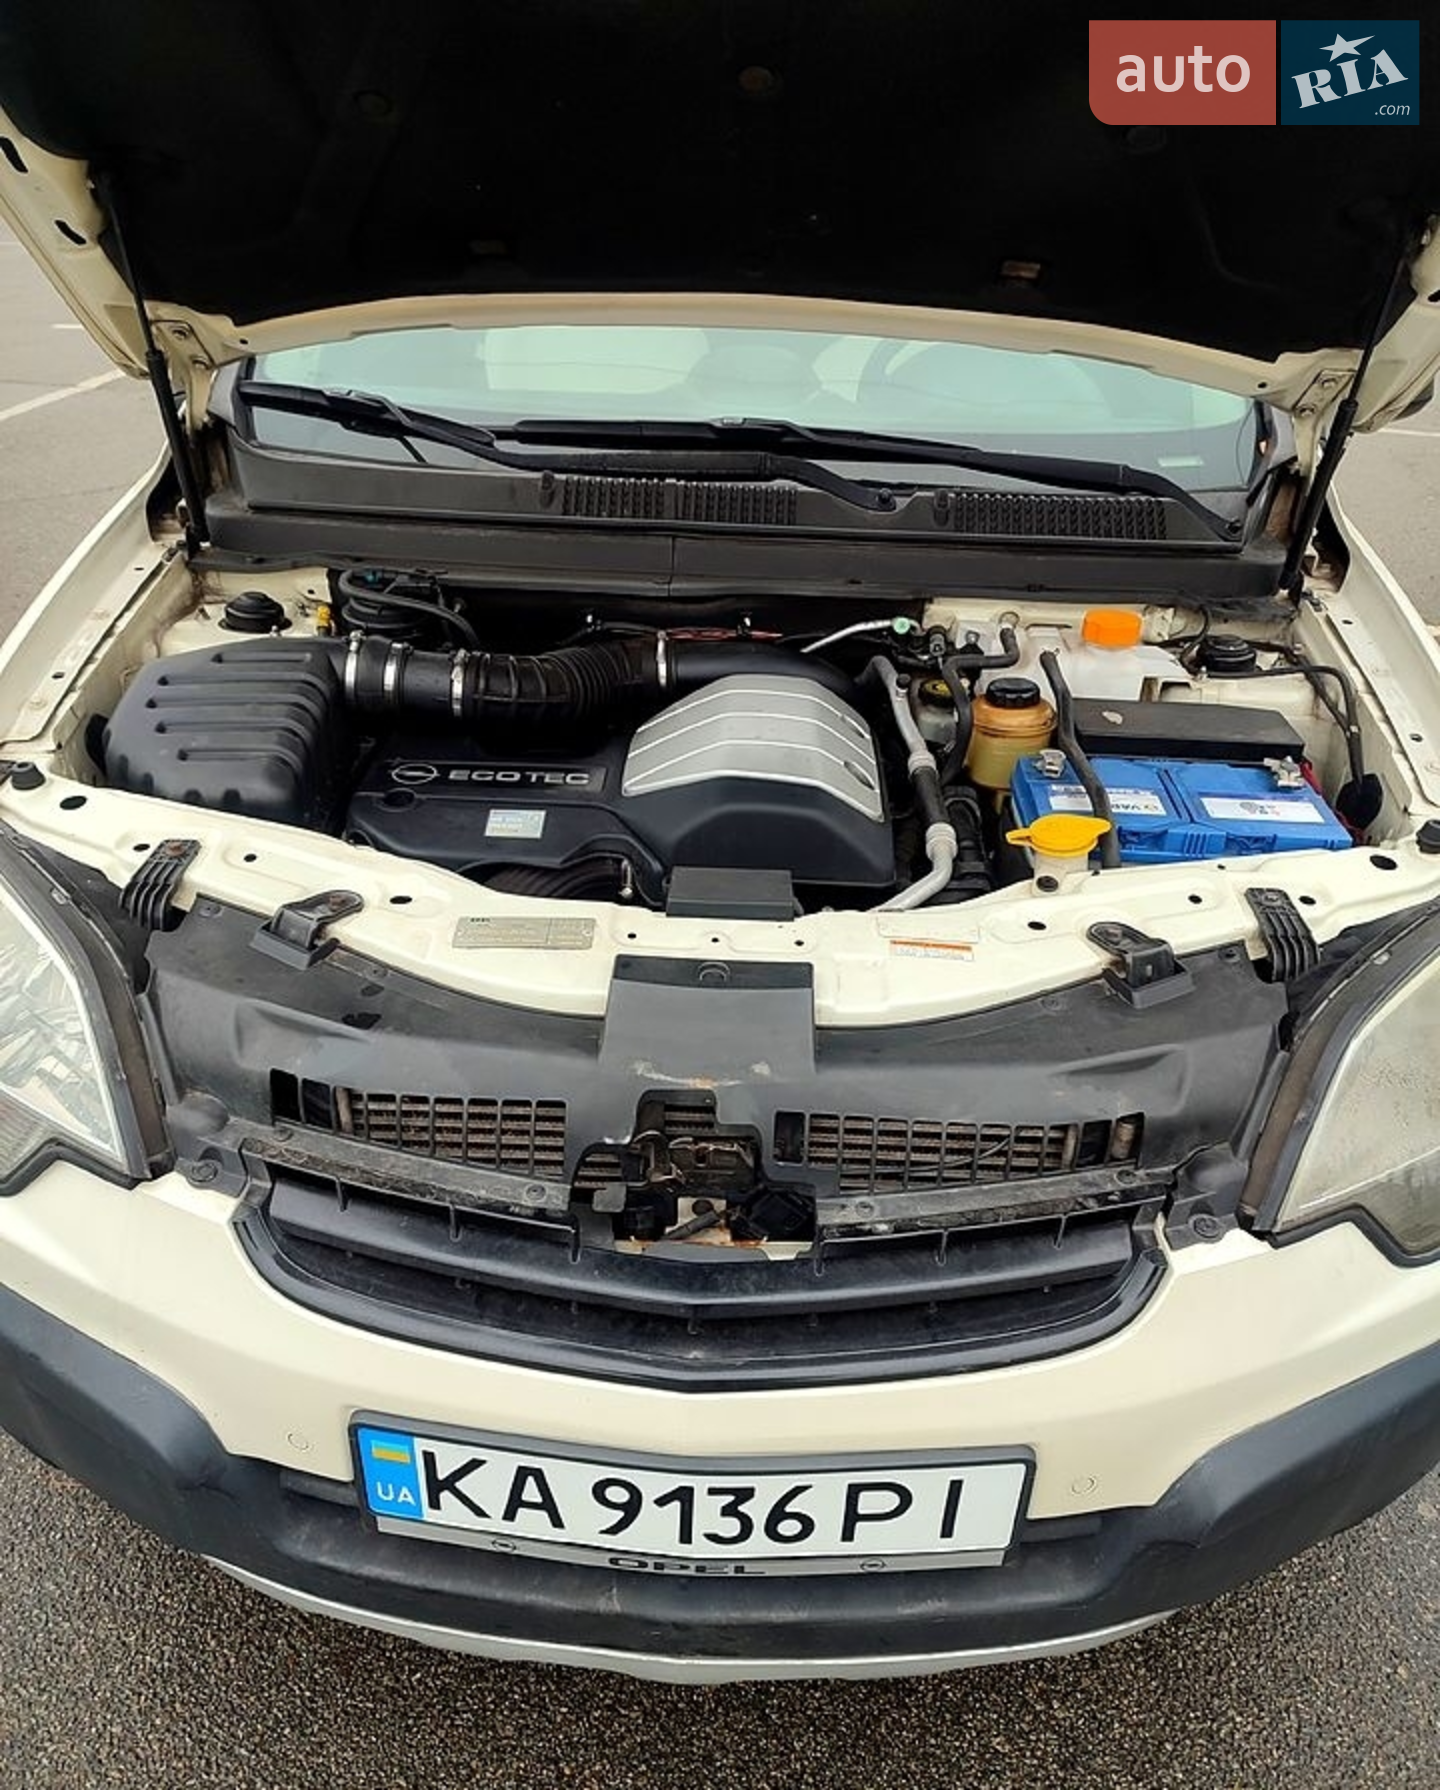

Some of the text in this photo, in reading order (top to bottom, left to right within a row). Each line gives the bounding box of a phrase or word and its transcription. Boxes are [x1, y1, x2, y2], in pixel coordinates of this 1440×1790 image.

[448, 769, 590, 785] ECOTEC
[376, 1481, 416, 1506] UA
[422, 1450, 964, 1545] KA 9136 PI
[608, 1557, 766, 1575] OPEL
